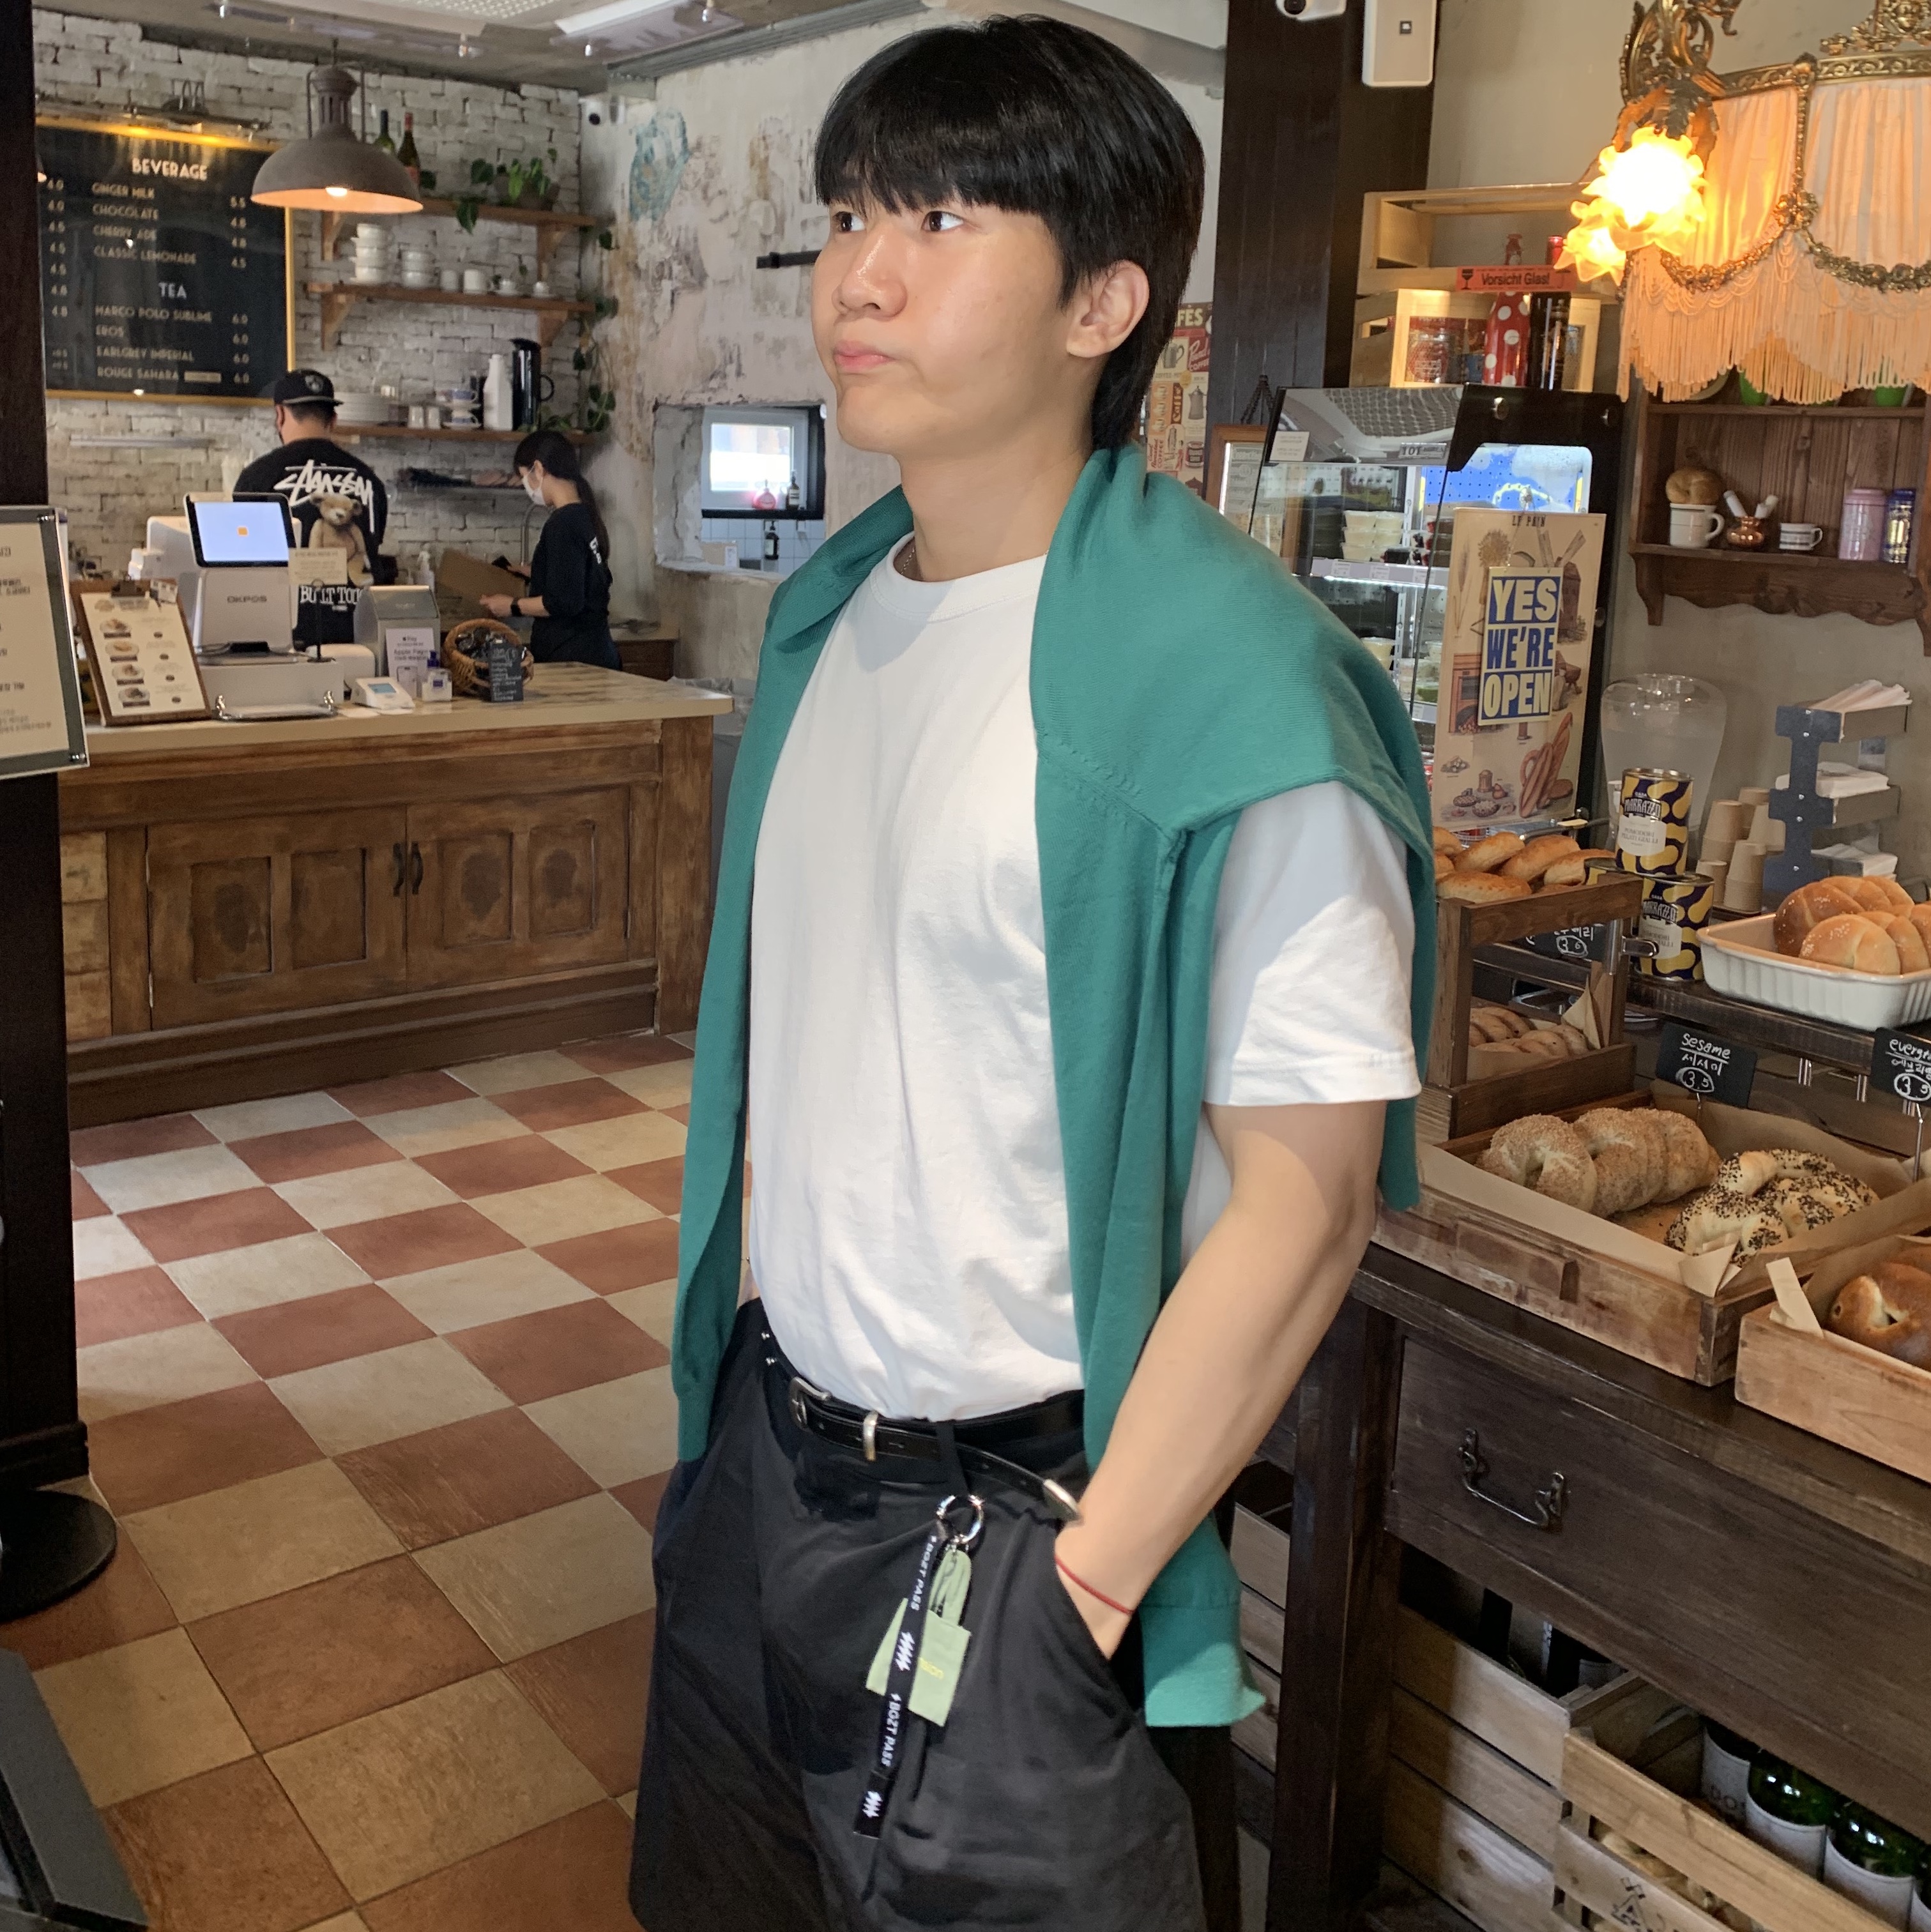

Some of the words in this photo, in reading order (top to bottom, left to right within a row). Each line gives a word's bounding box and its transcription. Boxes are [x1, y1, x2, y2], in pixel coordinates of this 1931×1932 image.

[132, 158, 208, 181] BEVERAGE
[93, 203, 158, 222] CHOCOLATE
[141, 250, 196, 264] LEMONADE
[1481, 273, 1522, 285] Vorsicht
[158, 282, 187, 300] TEA
[96, 305, 135, 317] MARCO
[138, 307, 169, 319] POLO
[137, 368, 179, 381] SAHARA
[227, 595, 267, 604] OKPOS
[300, 586, 335, 605] BULT
[1492, 578, 1557, 621] YES
[1486, 627, 1555, 669] WE'RE
[1483, 672, 1552, 718] OPEN
[1624, 798, 1661, 819] MARRAZZO
[1624, 828, 1654, 837] POMODORI
[1682, 1033, 1730, 1059] sesame
[910, 1578, 924, 1611] PASS
[881, 1735, 896, 1767] PASS
